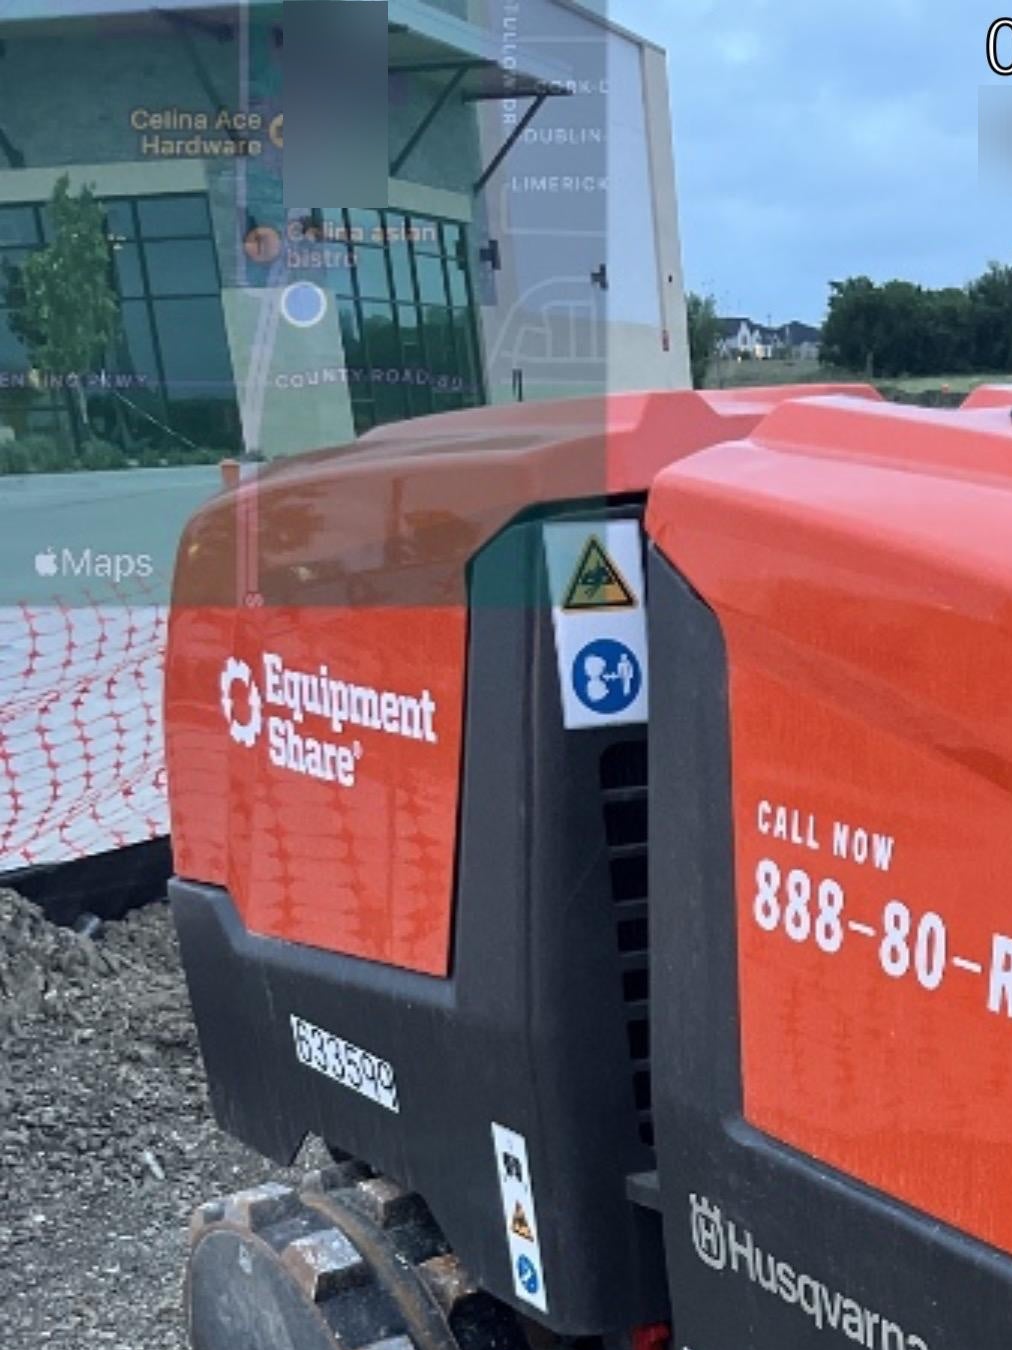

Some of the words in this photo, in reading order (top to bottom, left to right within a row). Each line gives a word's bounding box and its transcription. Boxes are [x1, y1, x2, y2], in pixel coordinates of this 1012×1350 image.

[263, 650, 438, 743] Equipment
[756, 800, 820, 850] CALL
[832, 821, 895, 871] NOW
